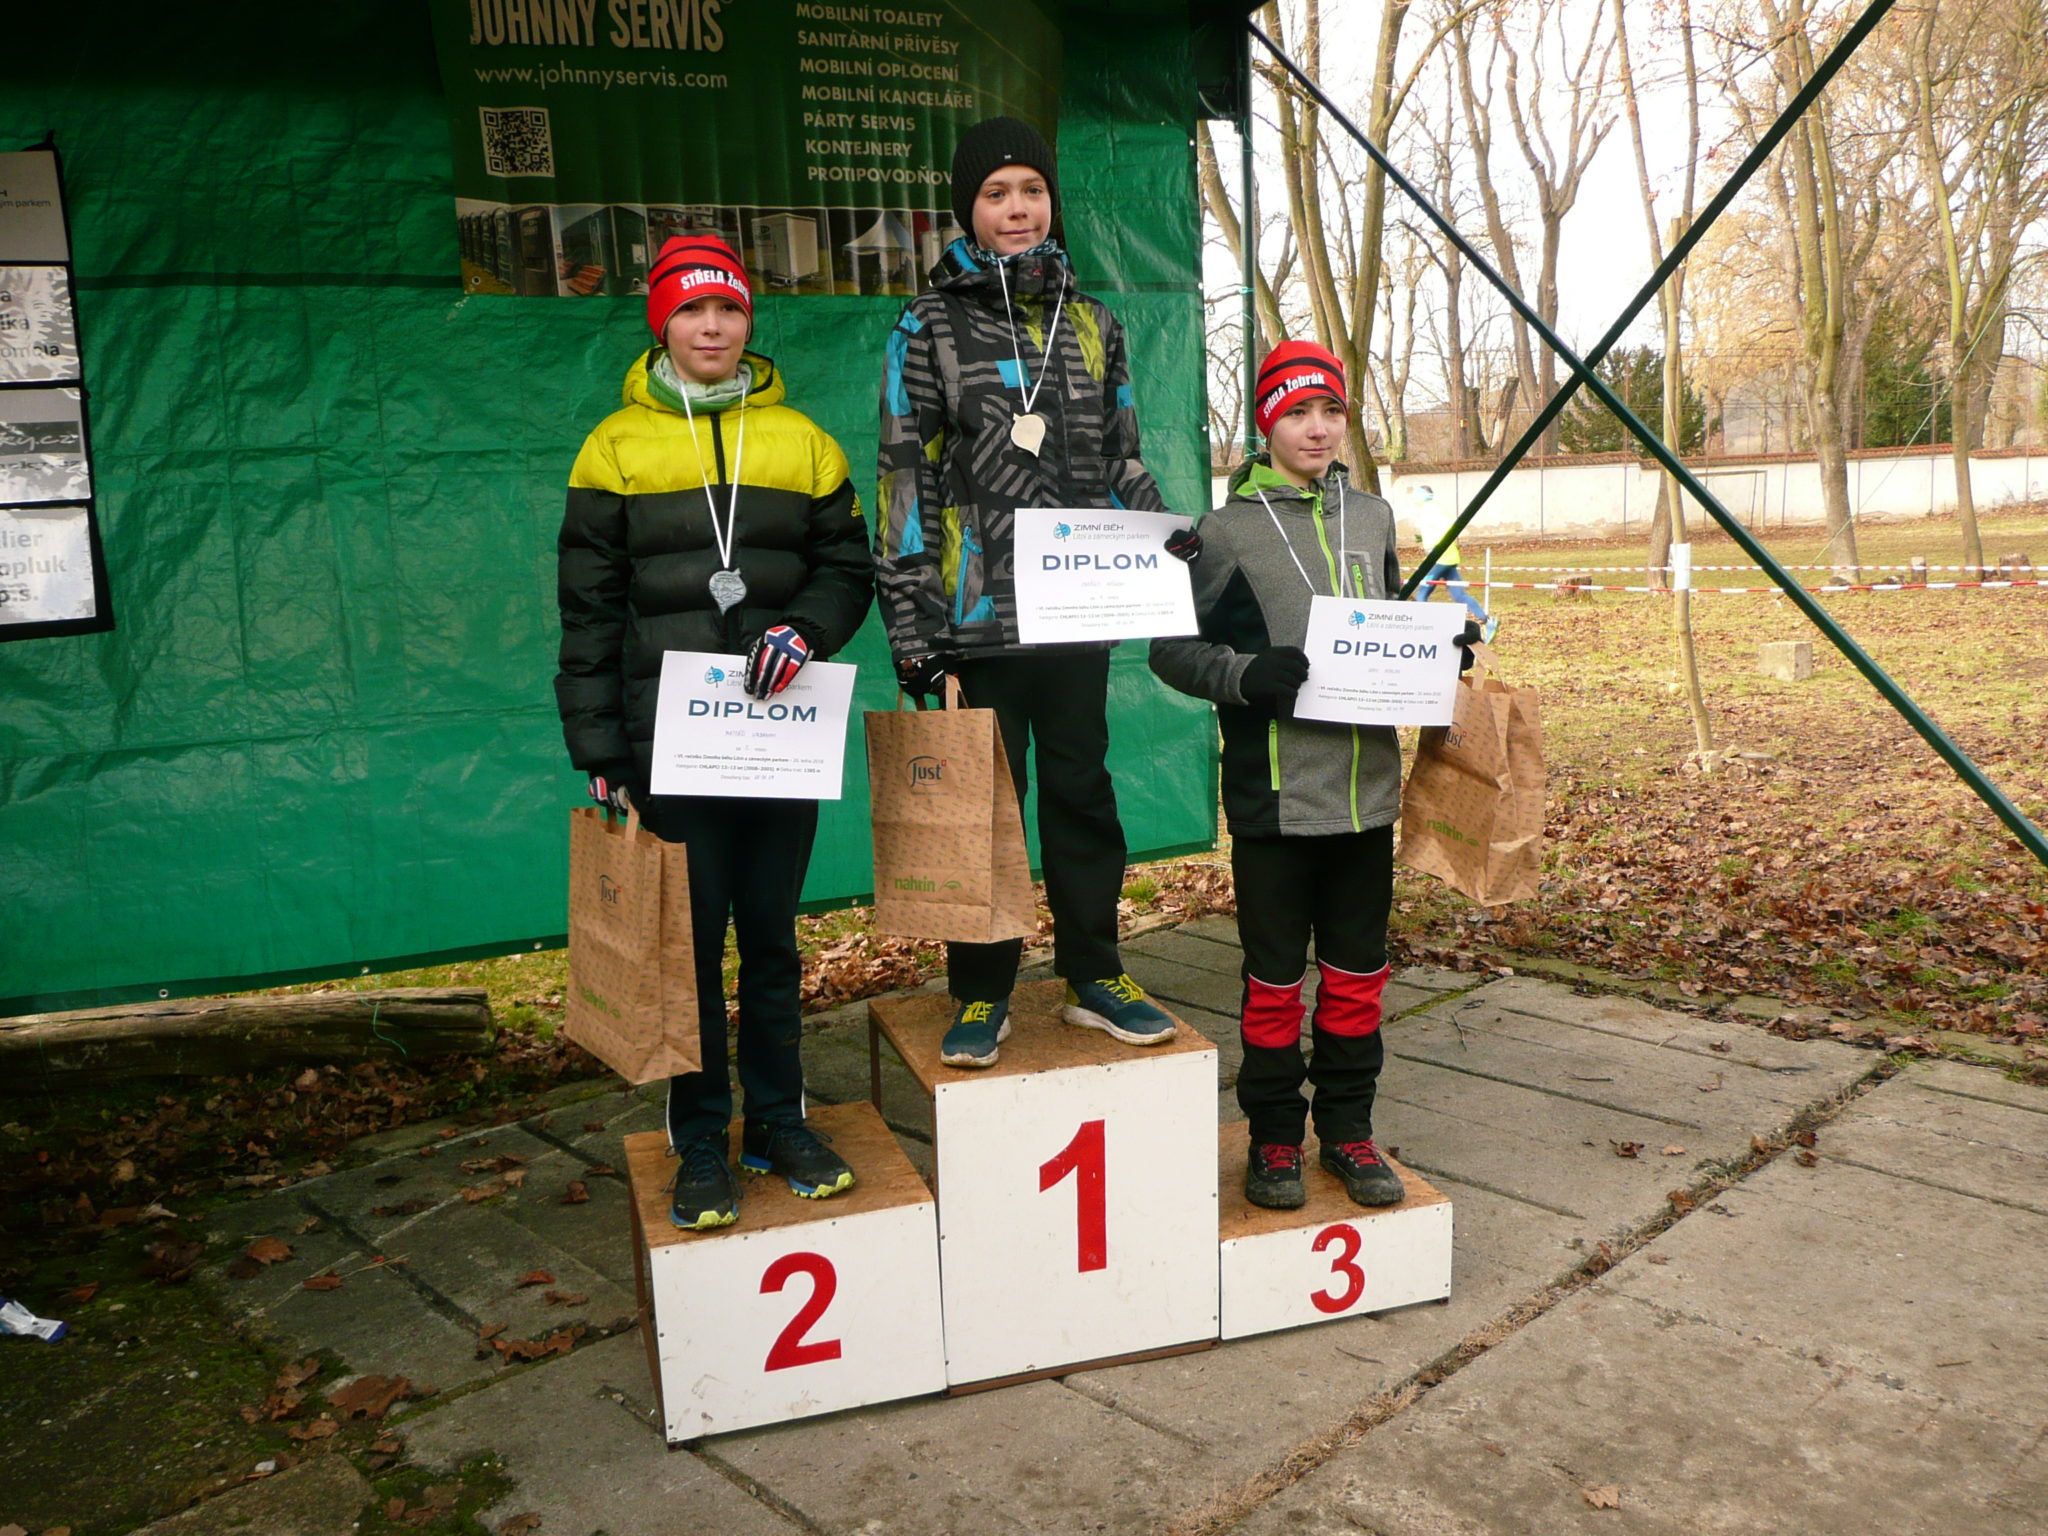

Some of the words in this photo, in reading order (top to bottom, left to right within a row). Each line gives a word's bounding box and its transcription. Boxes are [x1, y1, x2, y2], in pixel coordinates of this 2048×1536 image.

[469, 0, 597, 46] JOHNNY
[607, 0, 724, 52] SERVIS
[796, 2, 870, 22] MOBILNÍ
[873, 8, 943, 28] TOALETY
[797, 30, 890, 50] SANITÁRNÍ
[894, 33, 960, 56] PŘÍVĚSY
[473, 60, 728, 91] www.johnnyservis.com
[799, 57, 873, 76] MOBILNÍ
[877, 61, 959, 82] OPLOCENÍ
[801, 84, 875, 103] MOBILNÍ
[879, 89, 973, 109] KANCELÁŘE
[803, 109, 856, 129] PÁRTY
[861, 114, 916, 132] SERVIS
[805, 138, 912, 158] KONTEJNERY
[680, 268, 726, 290] STŘELA
[1285, 372, 1326, 393] Žebrák
[1074, 523, 1102, 531] ZIMNÍ
[1103, 522, 1124, 531] BĚH
[1042, 554, 1158, 571] DIPLOM
[1368, 613, 1393, 621] ZIMNÍ
[1395, 614, 1413, 622] BĚH
[1333, 639, 1438, 659] DIPLOM
[688, 699, 818, 723] DIPLOM
[894, 875, 937, 892] nahrin
[1039, 1118, 1107, 1273] 1
[1309, 1222, 1366, 1314] 3
[759, 1251, 842, 1372] 2
